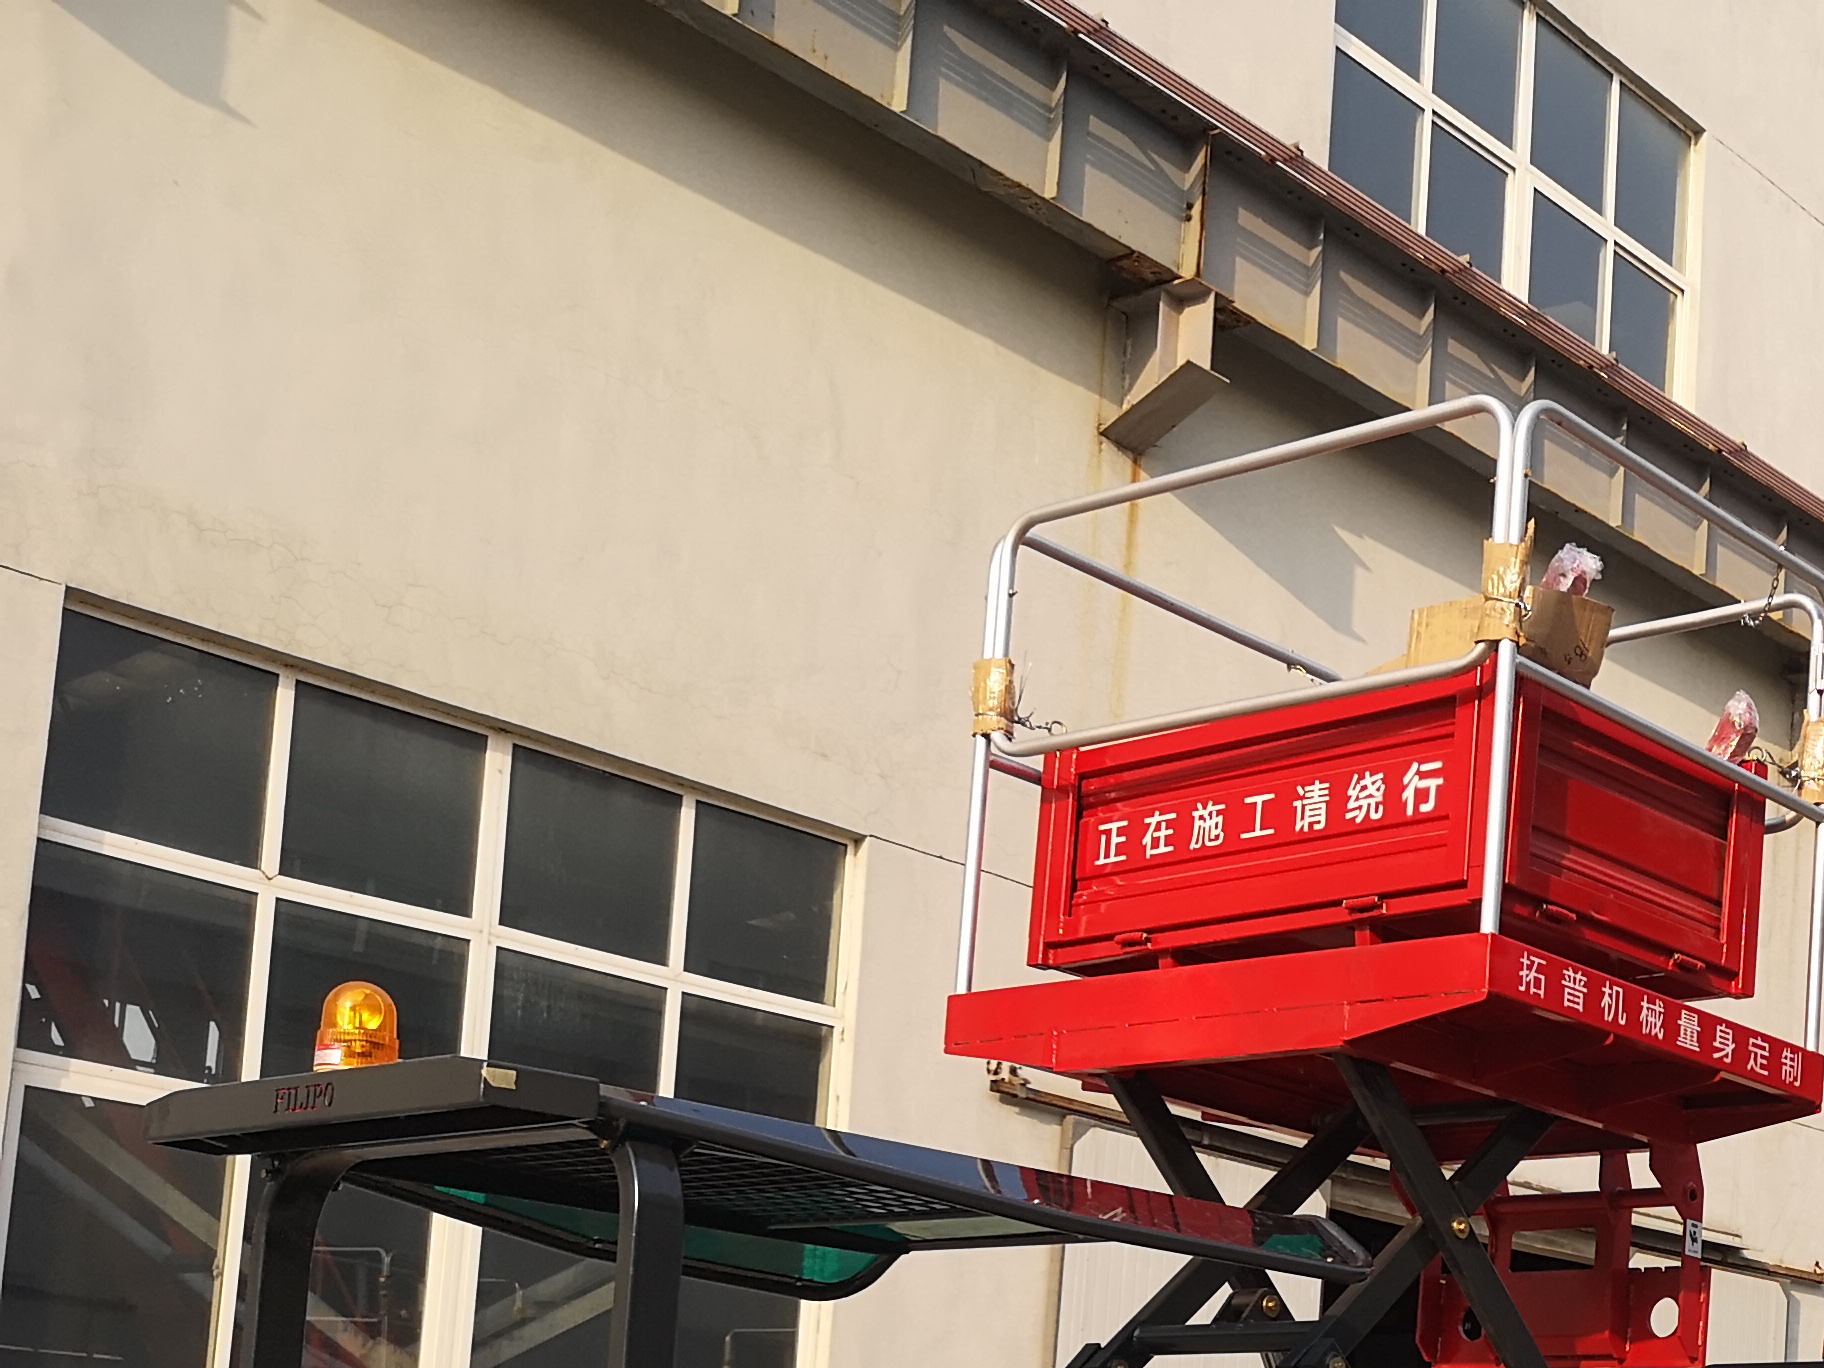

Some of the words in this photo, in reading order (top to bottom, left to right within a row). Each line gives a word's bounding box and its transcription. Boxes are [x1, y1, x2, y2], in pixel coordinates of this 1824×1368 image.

[1094, 760, 1445, 867] 正在施工请绕行
[1518, 950, 1802, 1087] 拓普机械量身定制
[273, 1082, 335, 1114] FILIPO
